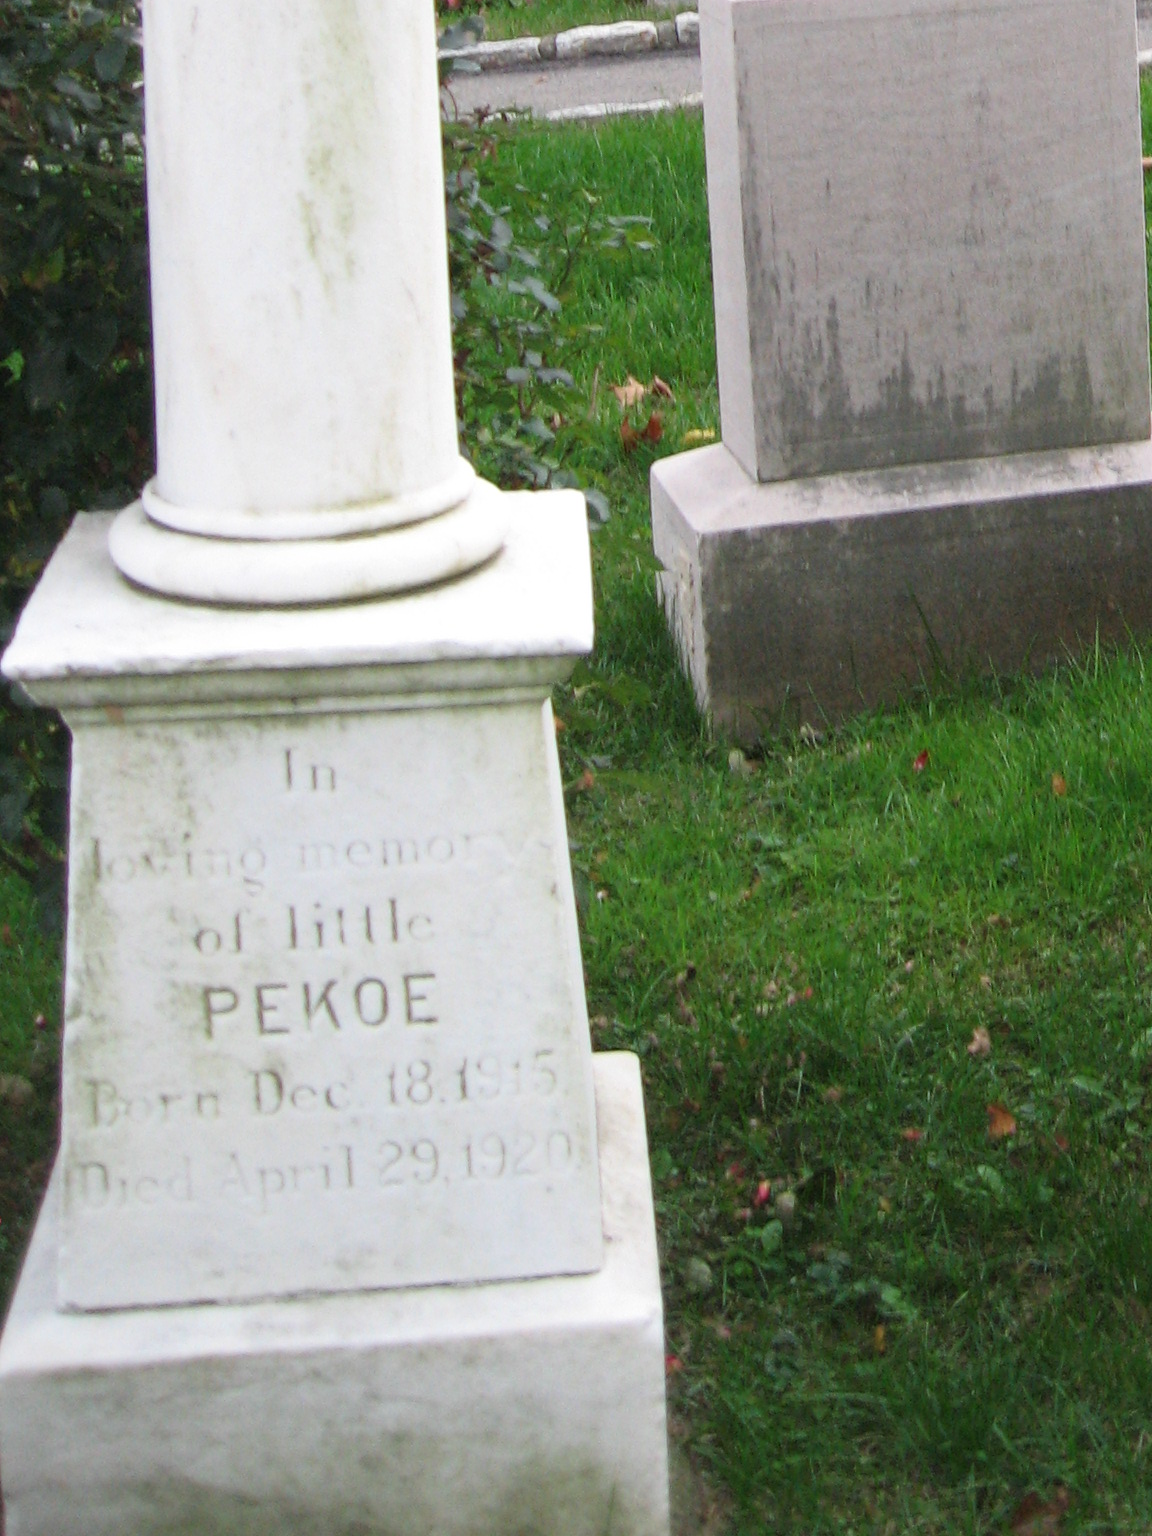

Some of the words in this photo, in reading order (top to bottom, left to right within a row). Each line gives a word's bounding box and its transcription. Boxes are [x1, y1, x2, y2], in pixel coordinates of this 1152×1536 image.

[281, 747, 337, 791] In
[89, 830, 266, 897] loving
[298, 828, 554, 870] memory
[193, 908, 245, 957] of
[286, 897, 436, 951] little
[204, 971, 440, 1041] PEKOE
[84, 1076, 221, 1129] Born
[72, 1154, 194, 1209] Died
[221, 1142, 355, 1215] April
